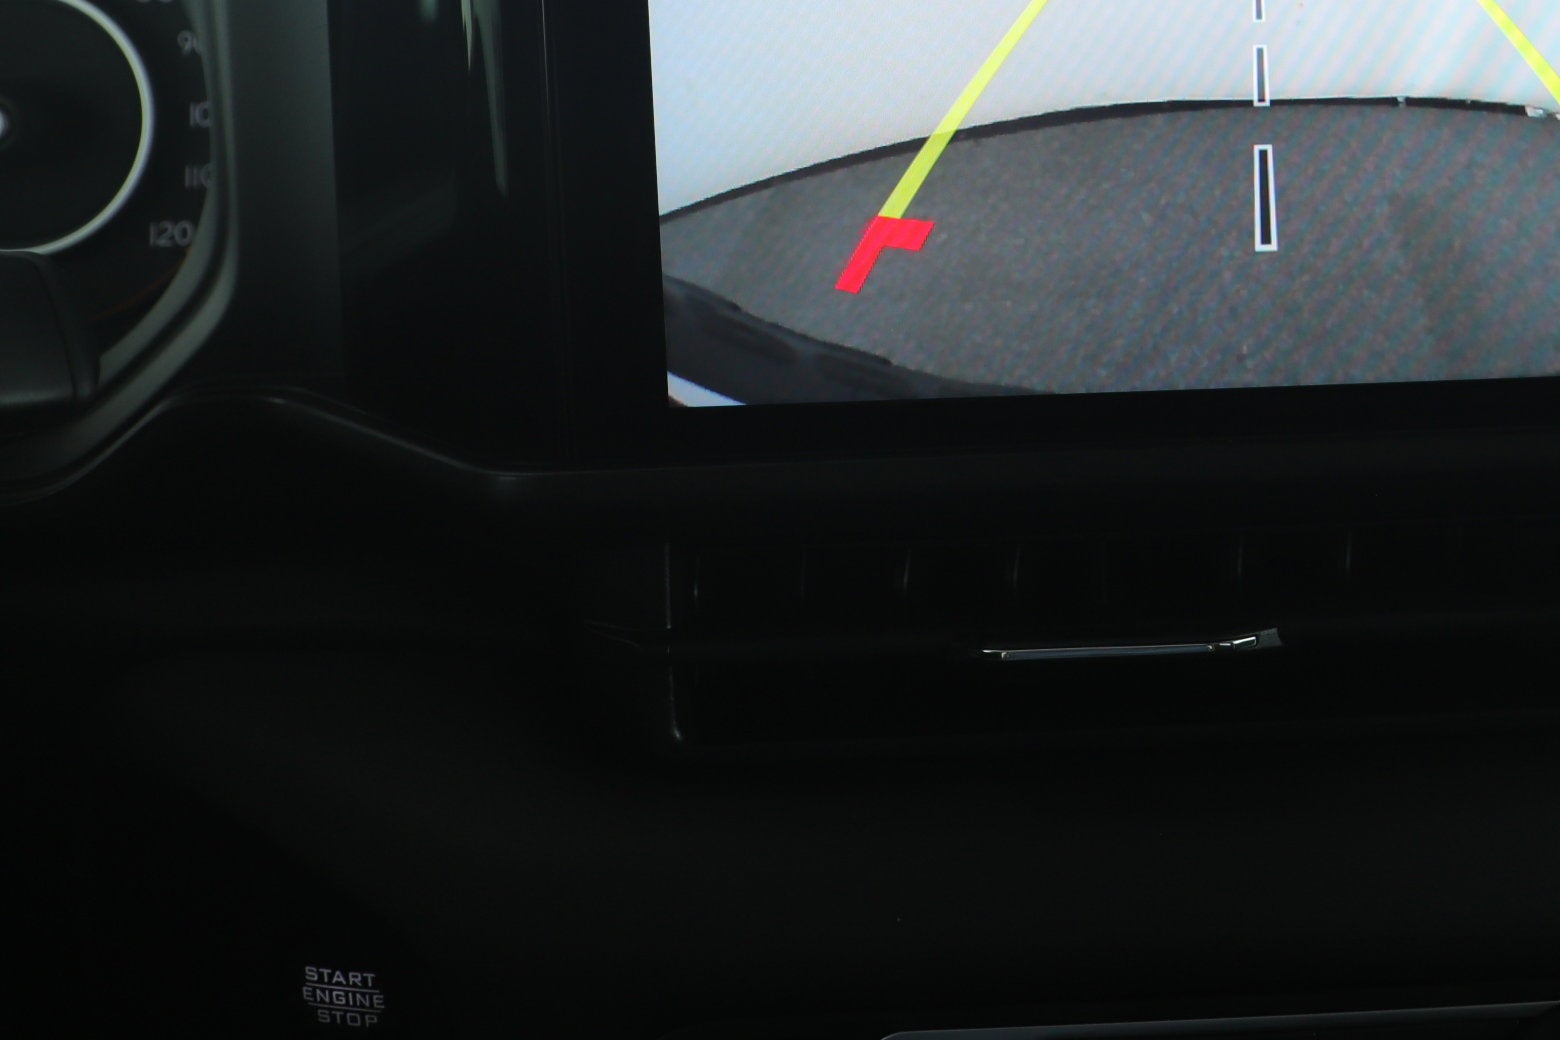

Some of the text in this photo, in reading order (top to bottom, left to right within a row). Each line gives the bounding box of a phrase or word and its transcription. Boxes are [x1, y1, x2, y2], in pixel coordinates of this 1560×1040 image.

[150, 220, 195, 248] 120
[304, 965, 376, 988] START
[302, 986, 386, 1009] ENGINE
[317, 1008, 378, 1028] STOP
